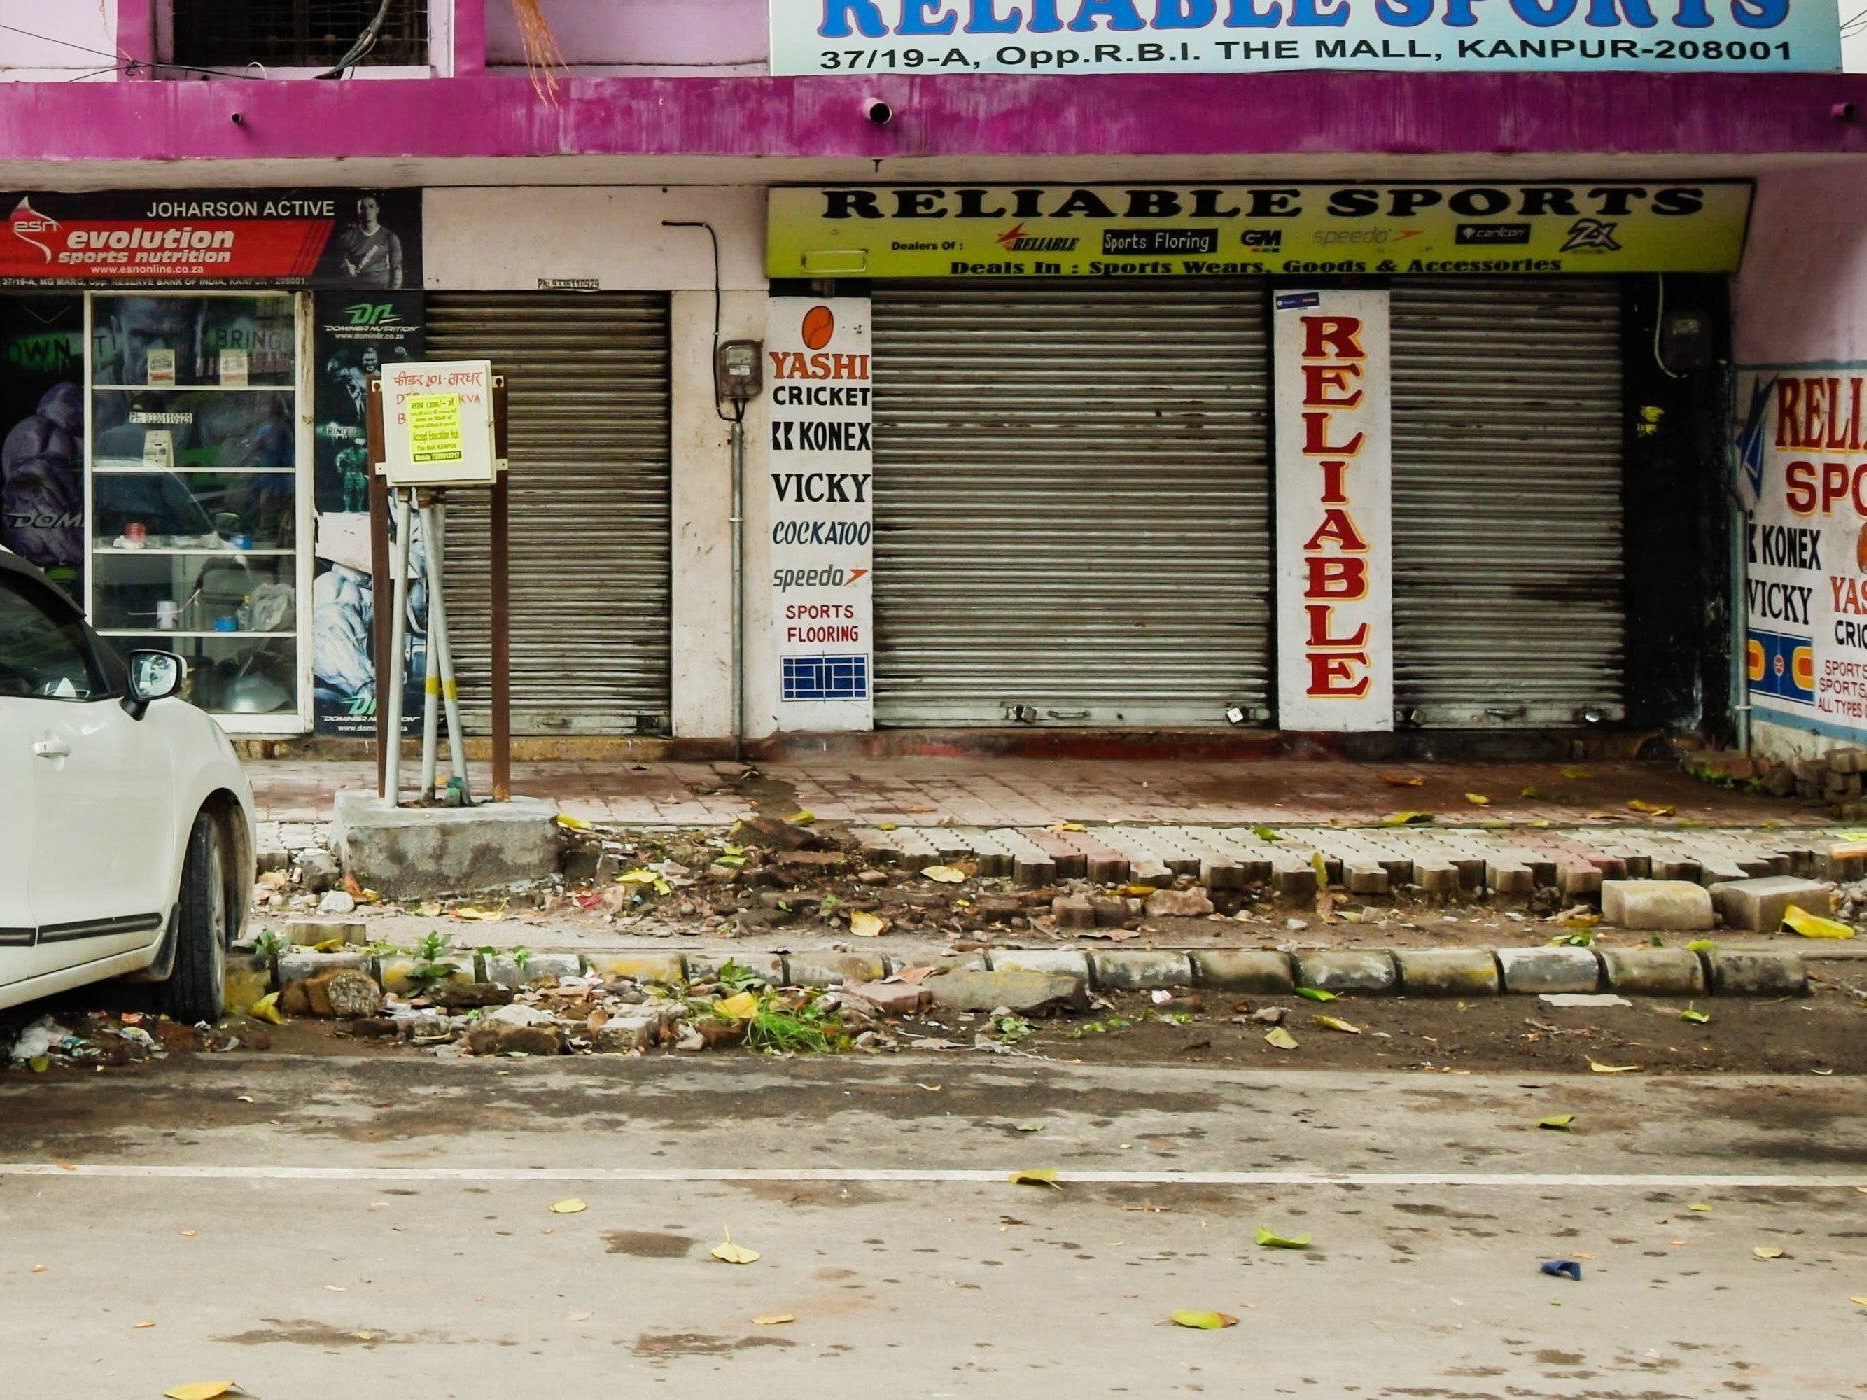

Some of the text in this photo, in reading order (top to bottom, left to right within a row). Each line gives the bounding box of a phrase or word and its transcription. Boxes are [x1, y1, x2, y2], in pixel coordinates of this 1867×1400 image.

[819, 38, 1792, 71] 37/19-A, Opp.R.B.I. THE MALL, KANPUR-208001
[147, 201, 335, 218] JOHARSON ACTIVE
[821, 186, 1705, 219] RELIABLE SPORTS
[66, 226, 235, 249] evolution
[891, 240, 957, 251] Dealers Of
[1013, 237, 1080, 252] RELIABLE
[1104, 232, 1210, 253] Sports Floring
[1312, 227, 1388, 245] speedo
[58, 250, 231, 265] sports nutrition
[951, 261, 1025, 275] Deals
[1034, 261, 1062, 275] In
[1089, 261, 1173, 277] Sports
[1282, 258, 1367, 274] Goods
[1375, 258, 1398, 273] &
[1407, 256, 1563, 273] Accessories
[91, 264, 204, 274] www.esnonline.co.za
[769, 352, 870, 380] YASHI
[772, 386, 871, 407] CRICKET
[1775, 377, 1867, 452] RELI
[799, 421, 871, 452] KONEX
[771, 473, 872, 503] VICKY
[1300, 315, 1370, 699] RELIABLE
[772, 519, 872, 546] COCKATOO
[1763, 525, 1822, 571] KONEX
[772, 564, 844, 593] speedo
[785, 603, 854, 621] SPORTS
[1748, 578, 1813, 625] VICKY
[787, 625, 859, 643] FLOORING
[1834, 700, 1862, 718] TYPES
